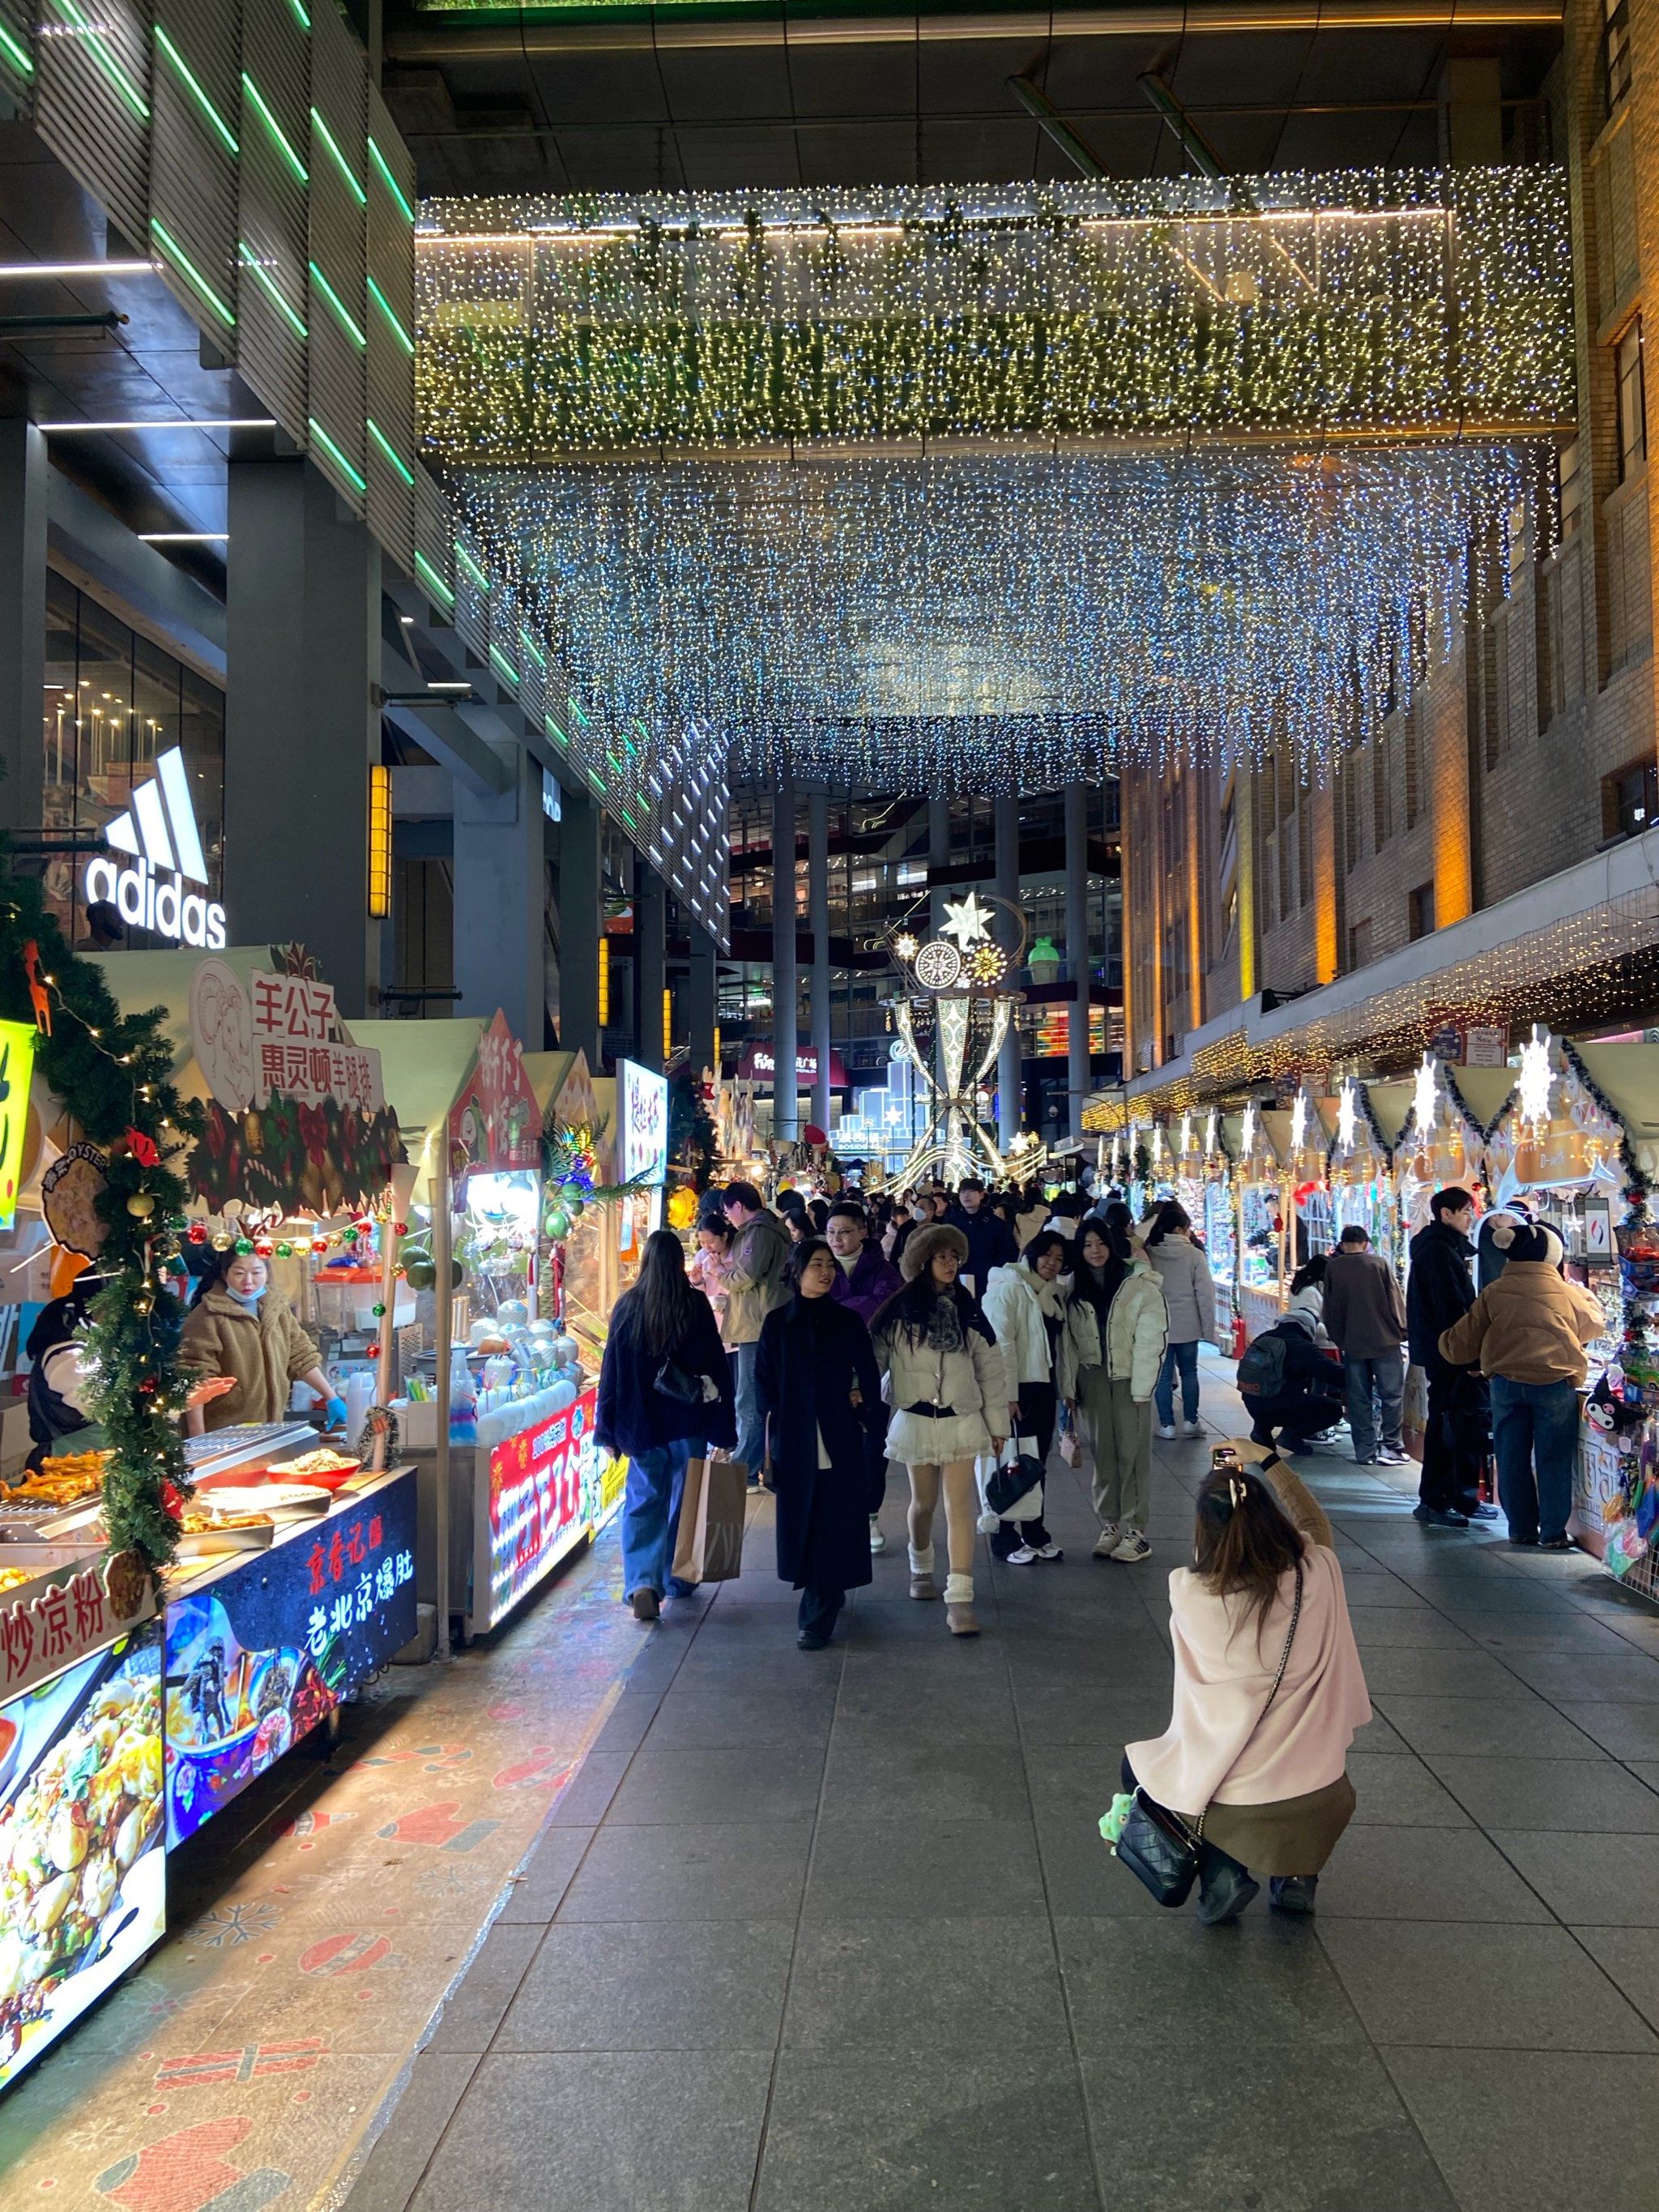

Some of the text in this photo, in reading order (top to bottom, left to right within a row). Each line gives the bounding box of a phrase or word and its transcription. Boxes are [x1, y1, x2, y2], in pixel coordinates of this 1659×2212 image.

[86, 856, 226, 950] adidas
[255, 980, 333, 1040] 羊公子
[1, 1570, 104, 1684] 炒凉粉
[304, 1549, 414, 1657] 老北京爆肚
